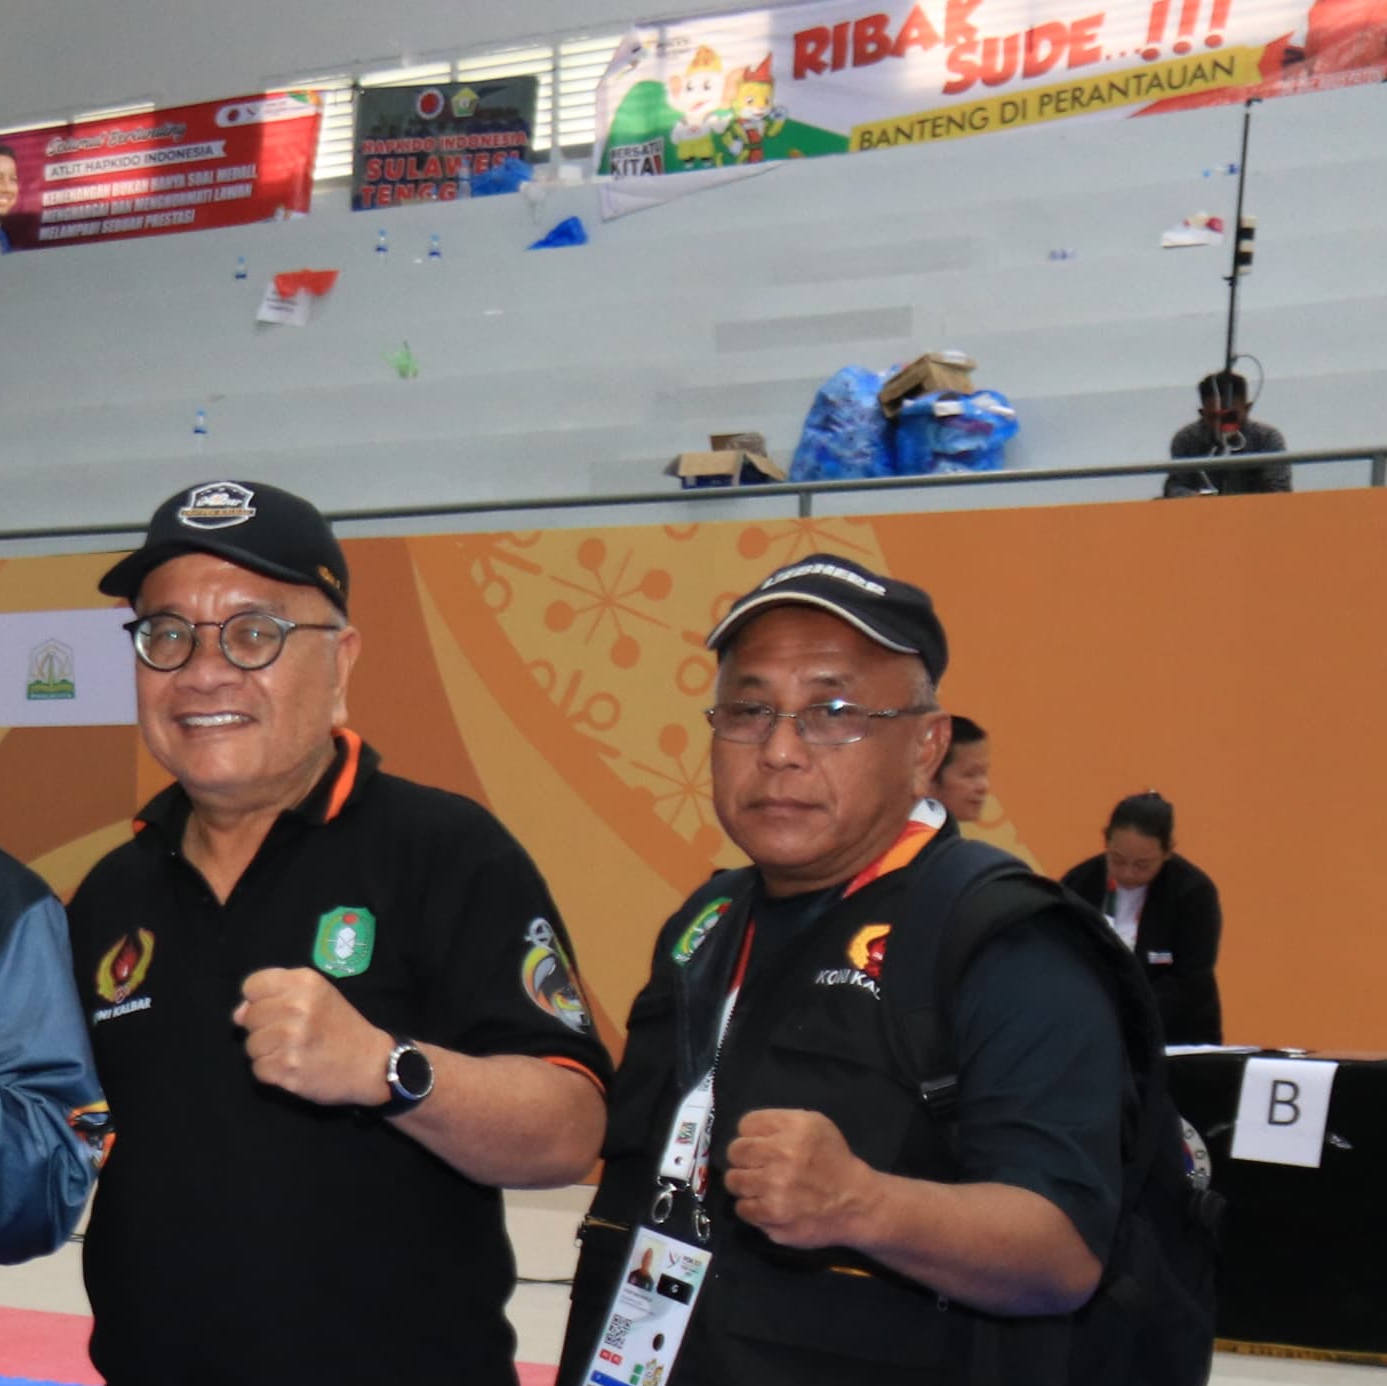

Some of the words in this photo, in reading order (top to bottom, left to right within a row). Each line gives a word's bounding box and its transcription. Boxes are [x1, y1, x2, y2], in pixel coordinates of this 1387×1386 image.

[793, 0, 987, 80] RIBAK
[859, 104, 991, 152] BANTENG
[1000, 99, 1027, 125] DI
[1038, 55, 1237, 117] PERANTAUAN
[50, 162, 84, 178] ATLIT
[85, 155, 142, 174] HAPKIDO
[144, 145, 215, 165] INDONESIA
[362, 137, 436, 155] HAPKIDO
[439, 131, 528, 150] INDONESIA
[361, 181, 458, 207] TENGG
[1267, 1079, 1300, 1126] B
